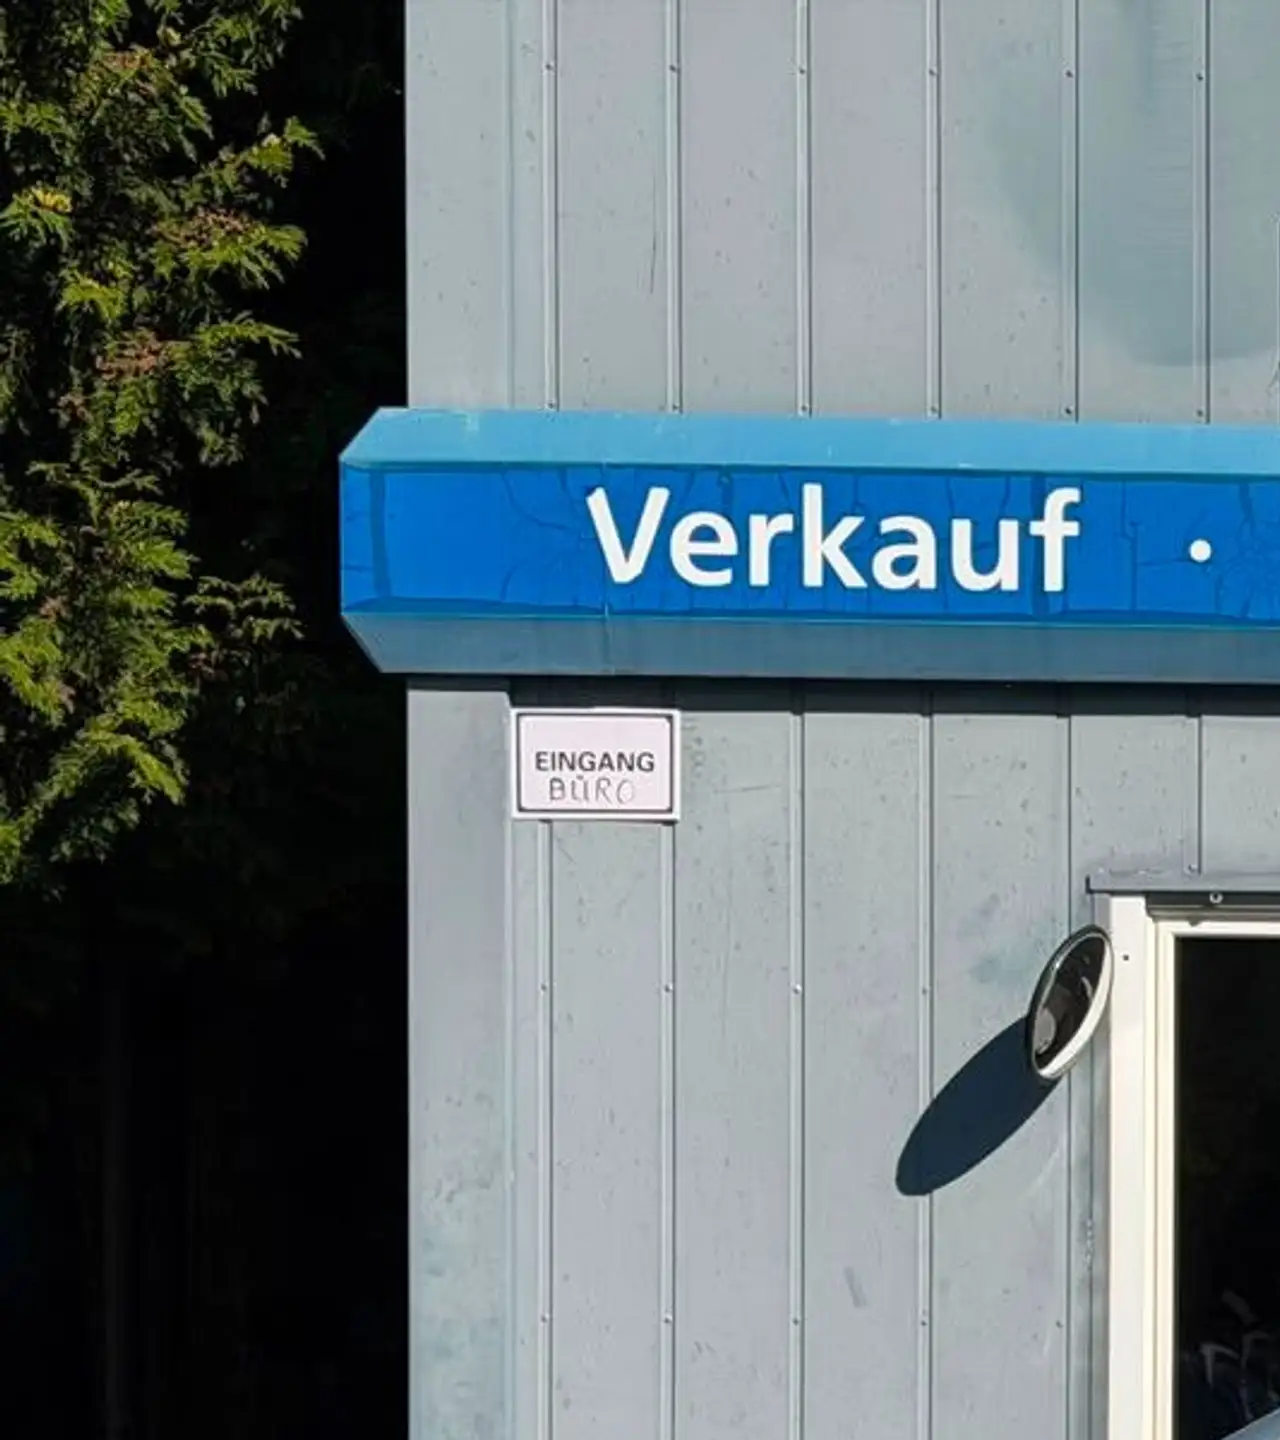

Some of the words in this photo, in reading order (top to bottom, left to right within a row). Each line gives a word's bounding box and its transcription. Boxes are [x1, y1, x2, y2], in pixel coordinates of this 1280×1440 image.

[587, 483, 1081, 592] Verkauf
[534, 750, 655, 773] EINGANG
[548, 774, 637, 804] BÜRO
